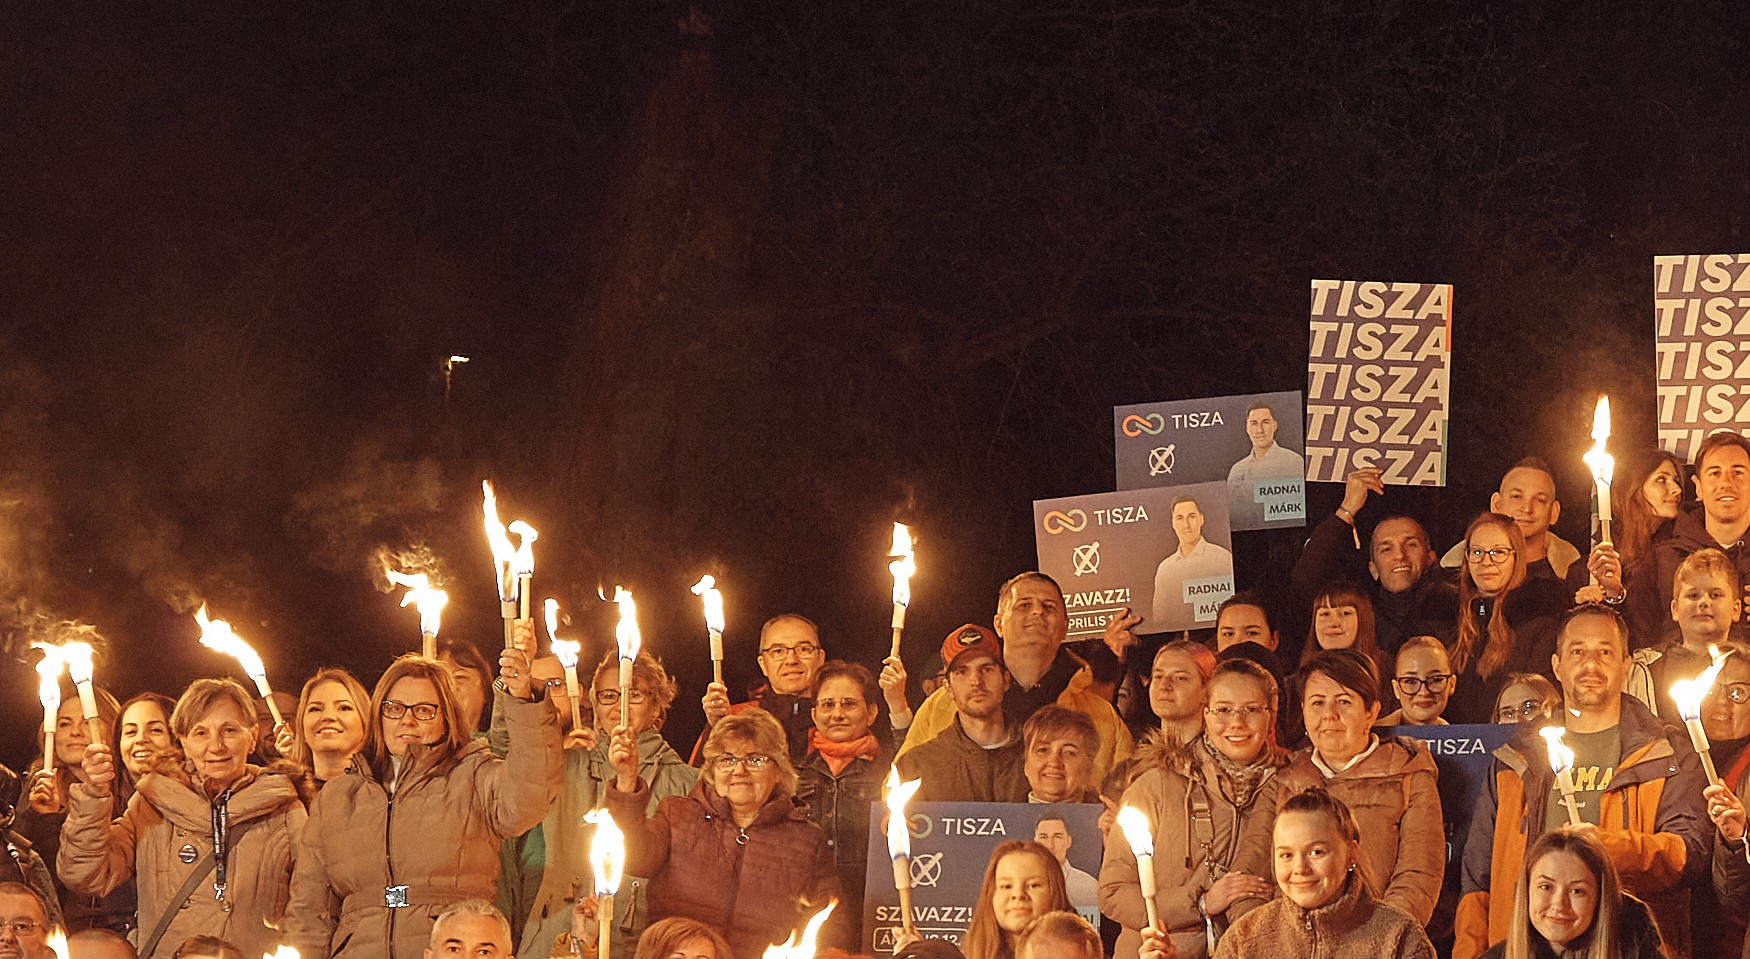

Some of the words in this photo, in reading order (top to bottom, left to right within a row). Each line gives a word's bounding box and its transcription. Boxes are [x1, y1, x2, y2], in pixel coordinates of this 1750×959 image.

[1311, 280, 1447, 320] TISZA
[1310, 322, 1447, 362] TISZA
[1308, 363, 1445, 403] TISZA
[1172, 412, 1224, 429] TISZA
[1306, 405, 1443, 445] TISZA
[1259, 484, 1301, 496] RADNAI
[1094, 505, 1149, 526] TISZA
[1269, 502, 1302, 514] MÁRK
[1063, 588, 1131, 607] ZAVAZZ!
[1188, 582, 1231, 596] RADNAI
[1068, 615, 1107, 630] PRILIS
[1425, 738, 1486, 755] TISZA
[942, 818, 1006, 836] TISZA
